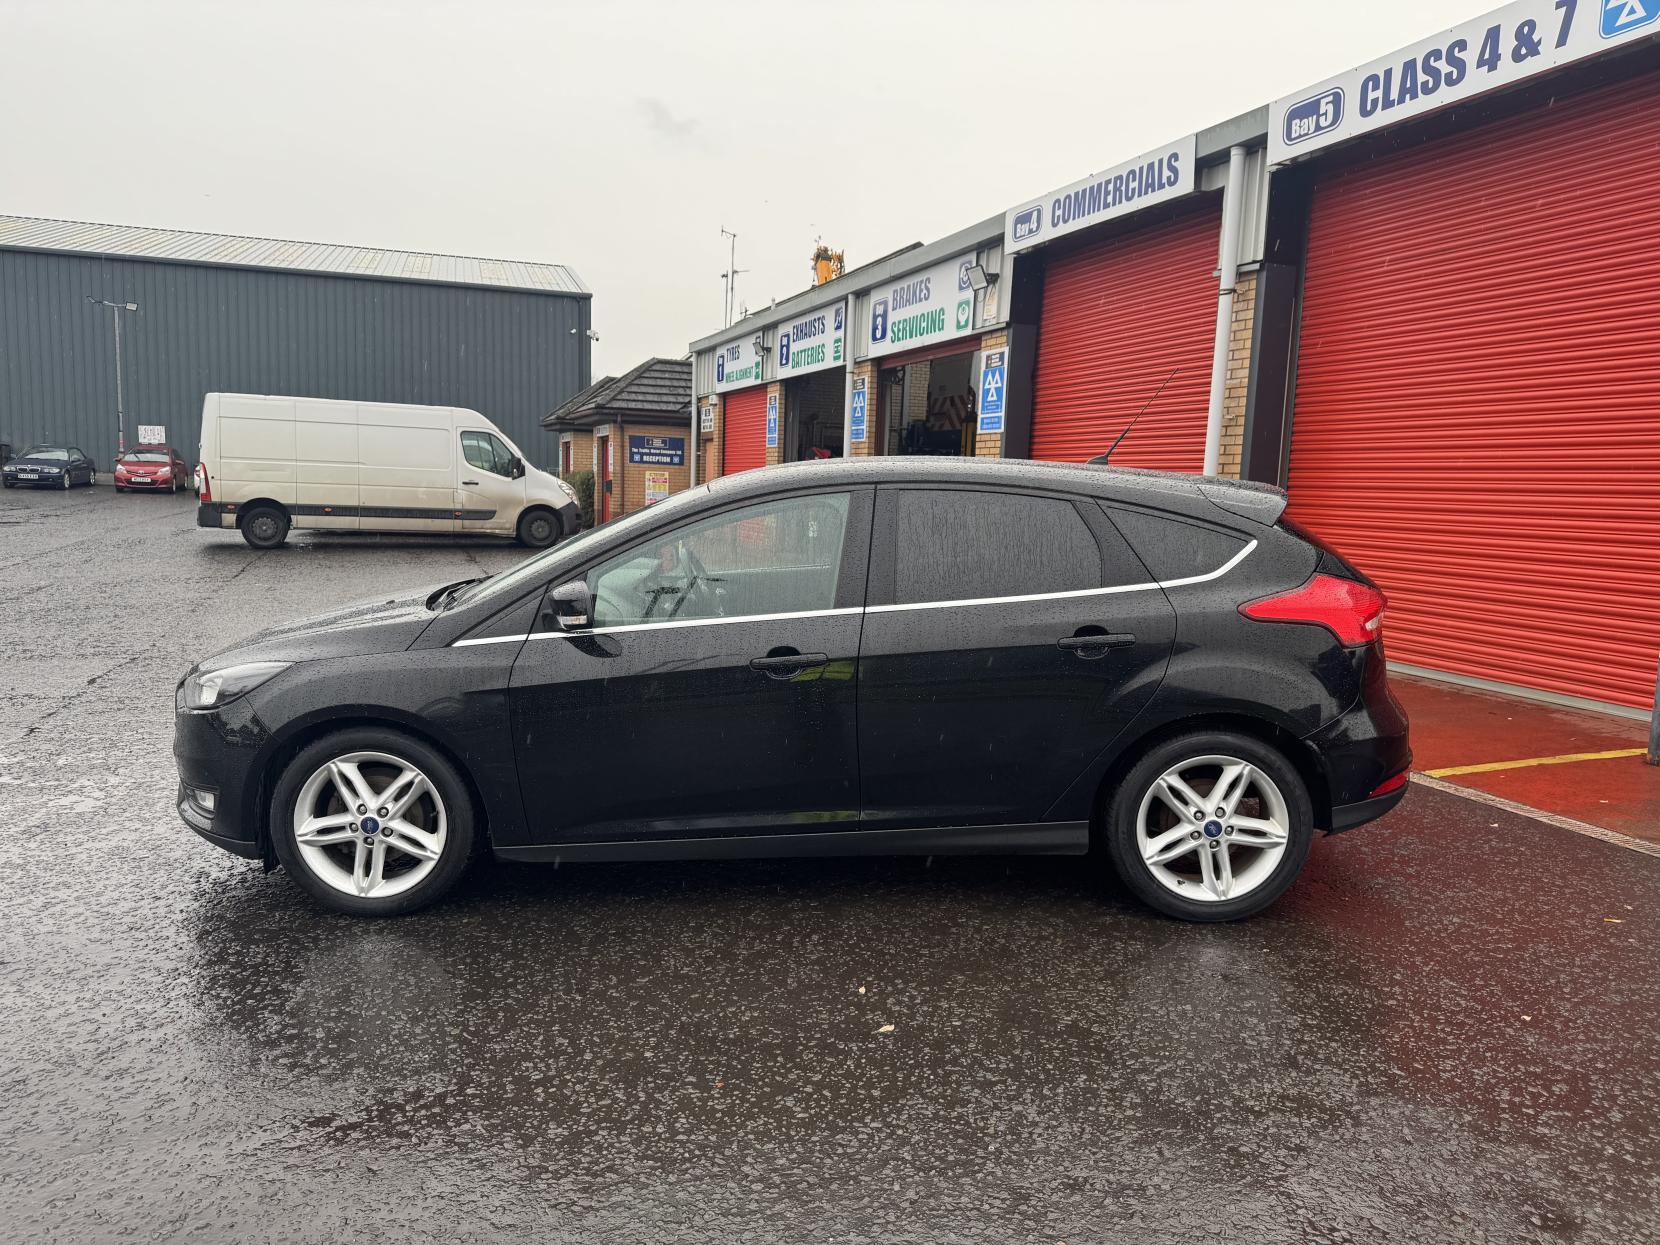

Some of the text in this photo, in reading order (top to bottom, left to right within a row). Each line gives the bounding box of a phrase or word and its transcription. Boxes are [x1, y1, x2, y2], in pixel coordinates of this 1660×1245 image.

[1359, 0, 1578, 118] CLASS 4 & 7
[1291, 95, 1334, 138] Bay 5
[1051, 152, 1180, 228] COMMERCIALS
[1016, 211, 1038, 237] Bay 4
[892, 277, 931, 311] BRAKES
[792, 315, 825, 343] EXHAUSTS
[876, 316, 882, 339] 3
[891, 307, 945, 343] SERVICING
[782, 347, 787, 364] 2
[791, 343, 825, 369] BATTERIES
[643, 455, 671, 463] RECEPTION
